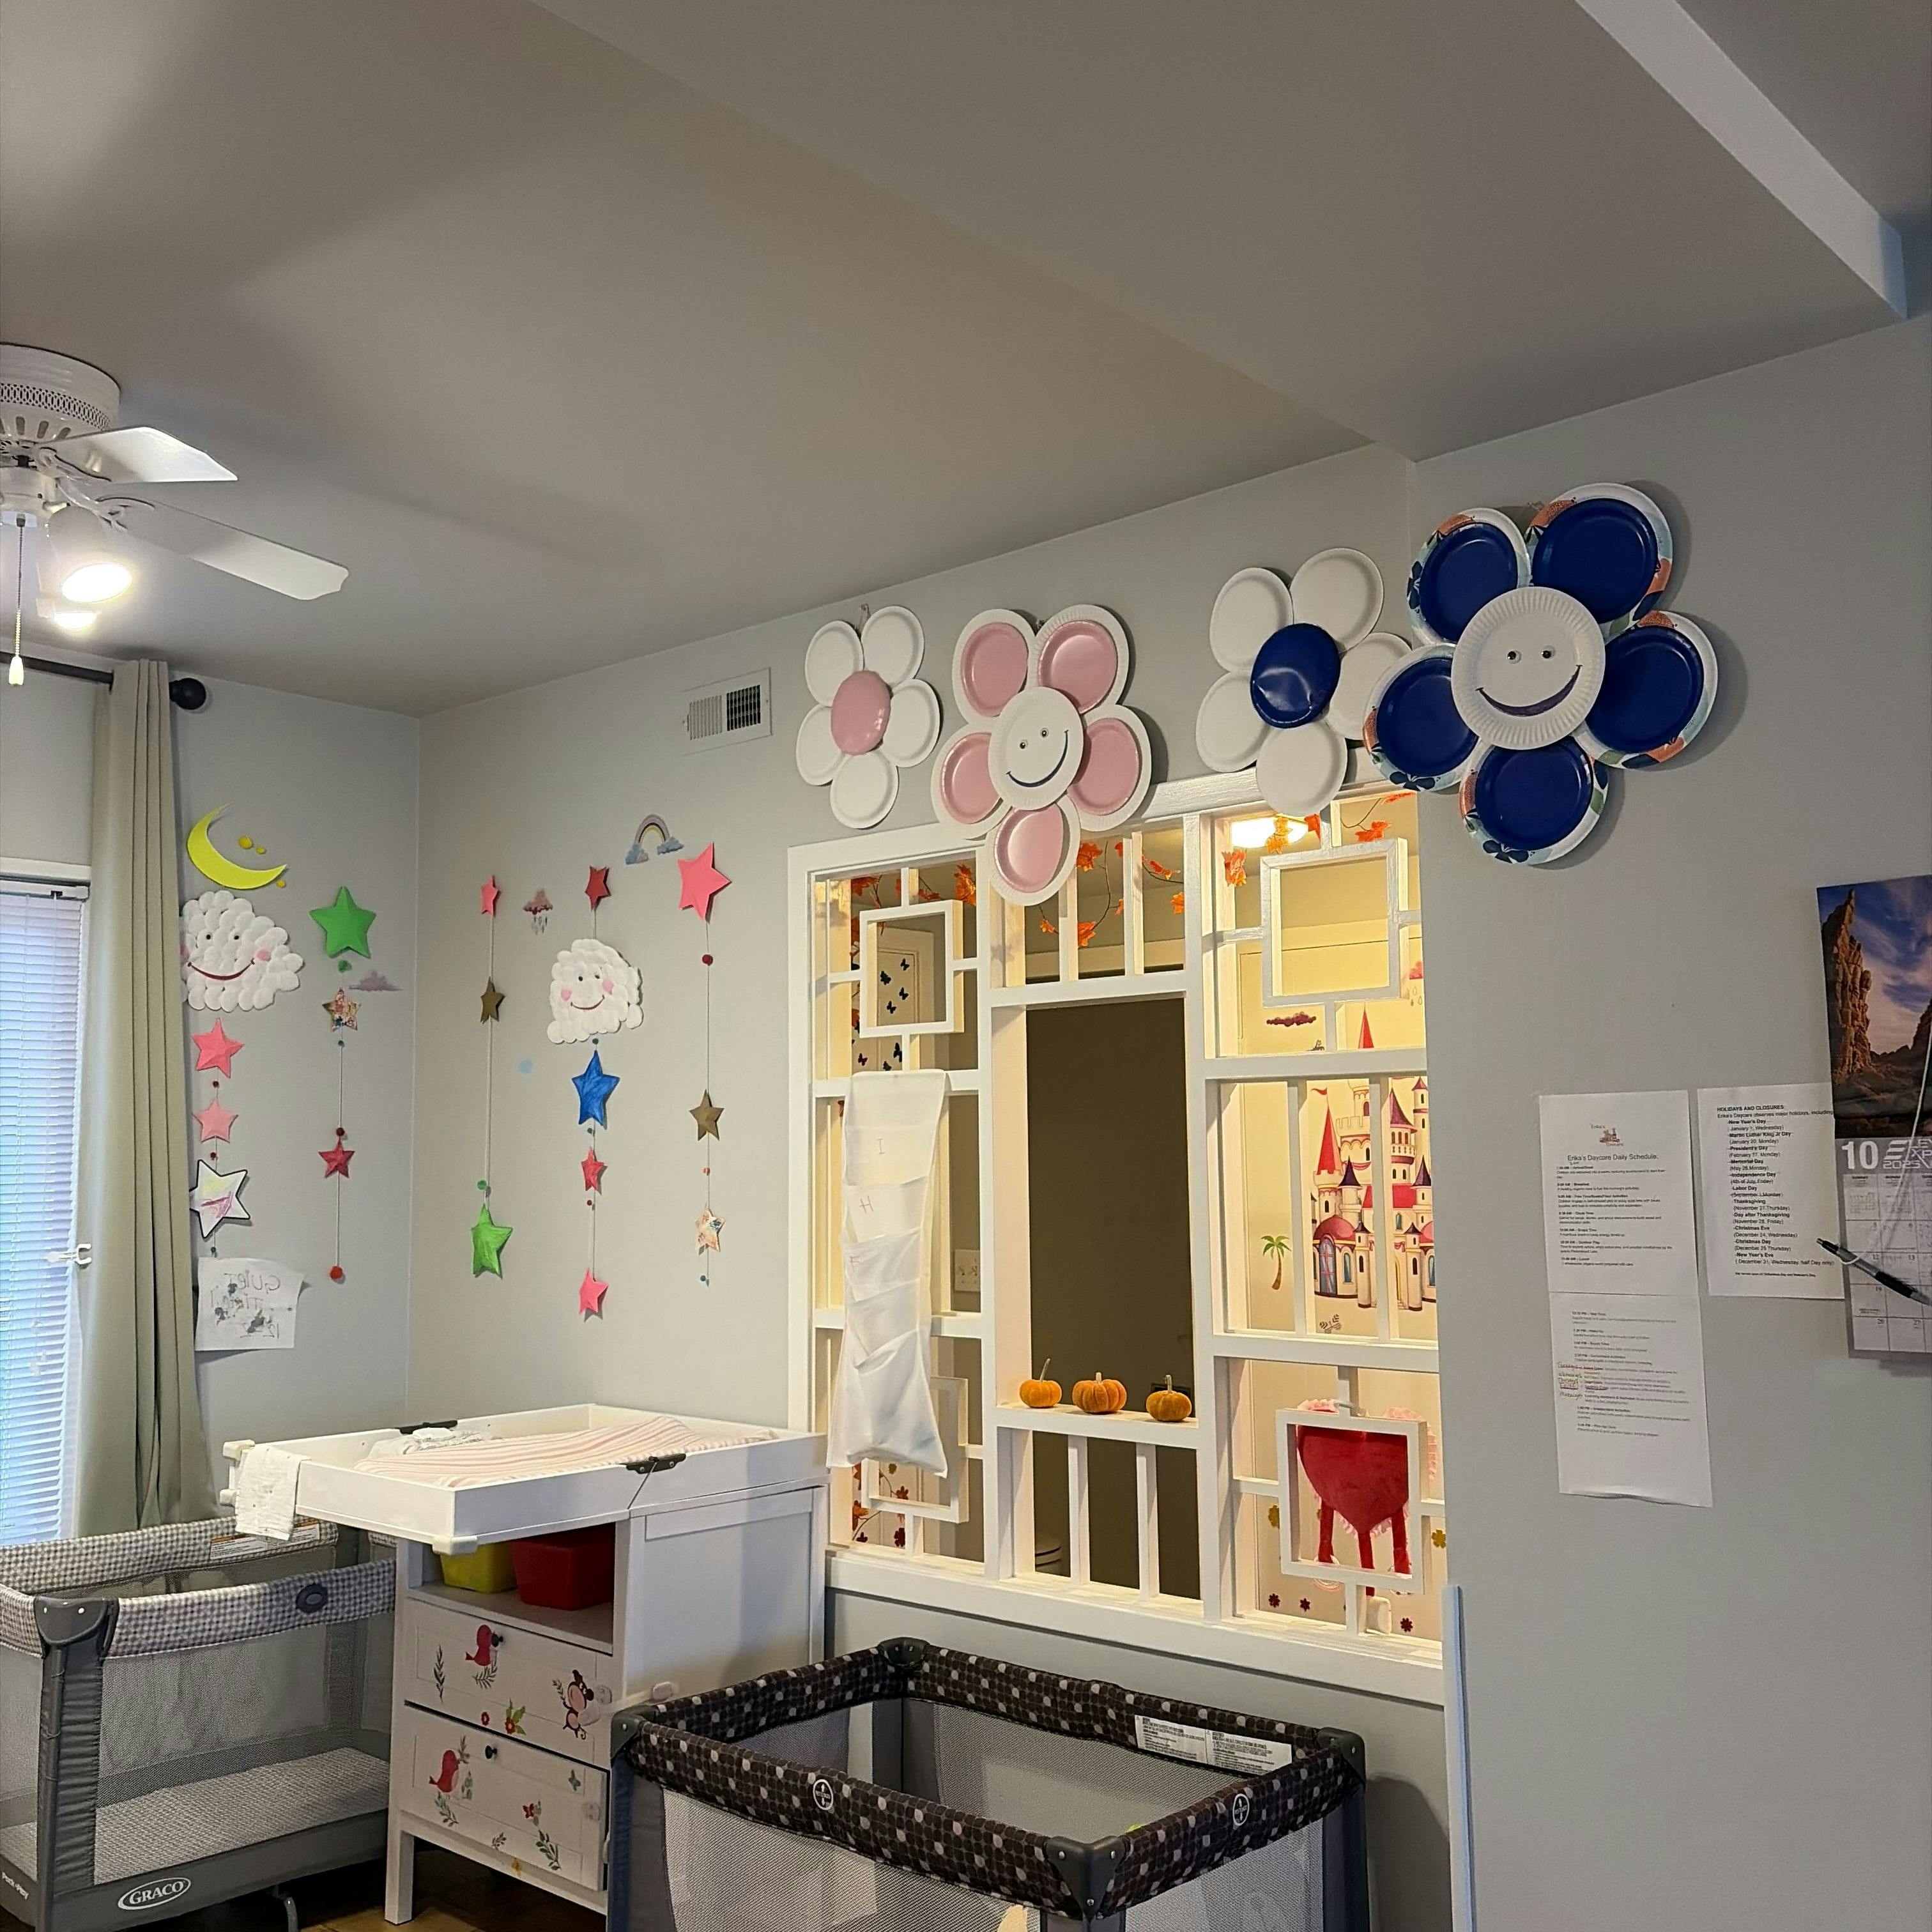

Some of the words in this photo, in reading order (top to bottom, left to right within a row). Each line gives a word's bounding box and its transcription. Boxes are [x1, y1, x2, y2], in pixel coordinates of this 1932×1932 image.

[1841, 1140, 1878, 1169] 10
[1883, 1160, 1920, 1169] 2025
[859, 1195, 874, 1213] H
[850, 1255, 862, 1272] F
[129, 1881, 184, 1905] GRACO
